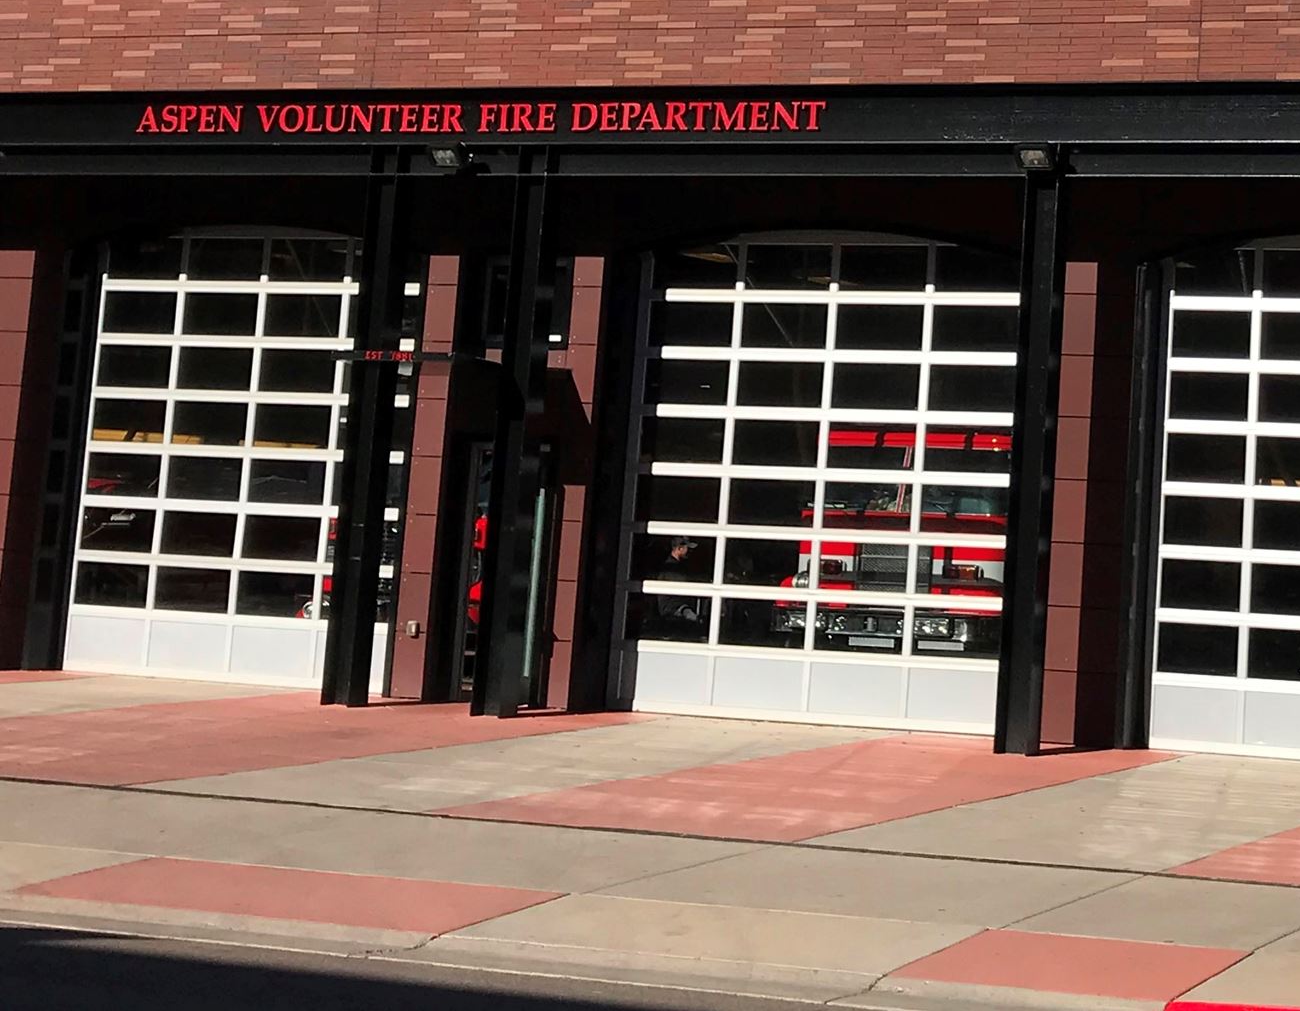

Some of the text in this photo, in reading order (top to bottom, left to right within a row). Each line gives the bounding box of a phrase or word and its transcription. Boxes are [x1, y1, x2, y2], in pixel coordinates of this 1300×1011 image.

[136, 101, 826, 133] ASPEN VOLUNTEER FIRE DEPARTMENT
